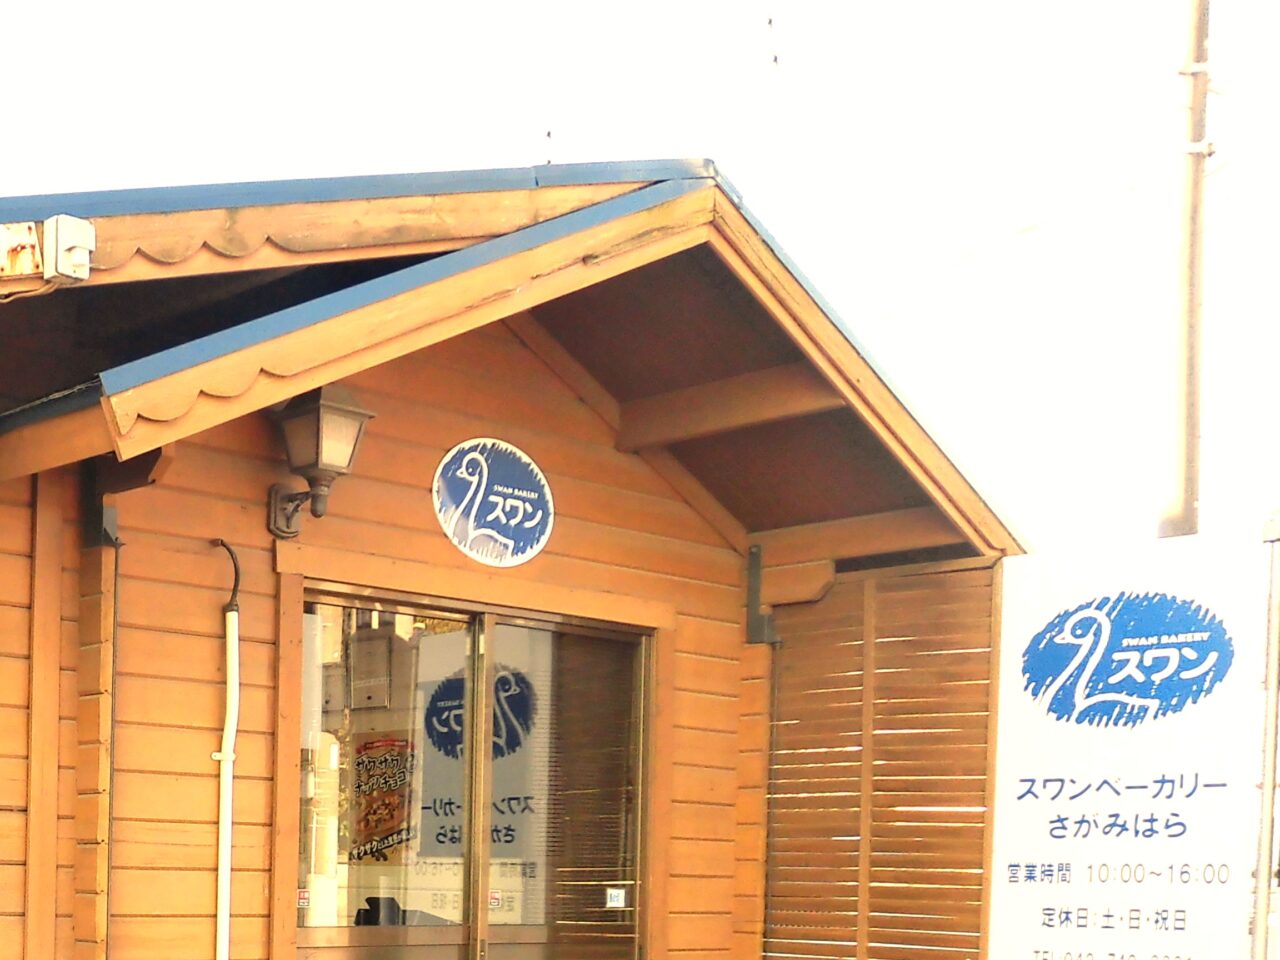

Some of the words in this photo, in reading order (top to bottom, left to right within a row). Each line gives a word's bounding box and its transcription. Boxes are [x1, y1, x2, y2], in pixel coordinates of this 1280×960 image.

[486, 494, 543, 528] スワン
[1107, 647, 1219, 685] スワン
[1016, 773, 1228, 801] スワンベーカリー
[1048, 812, 1187, 839] さがみはら
[1007, 862, 1072, 884] 営業時間
